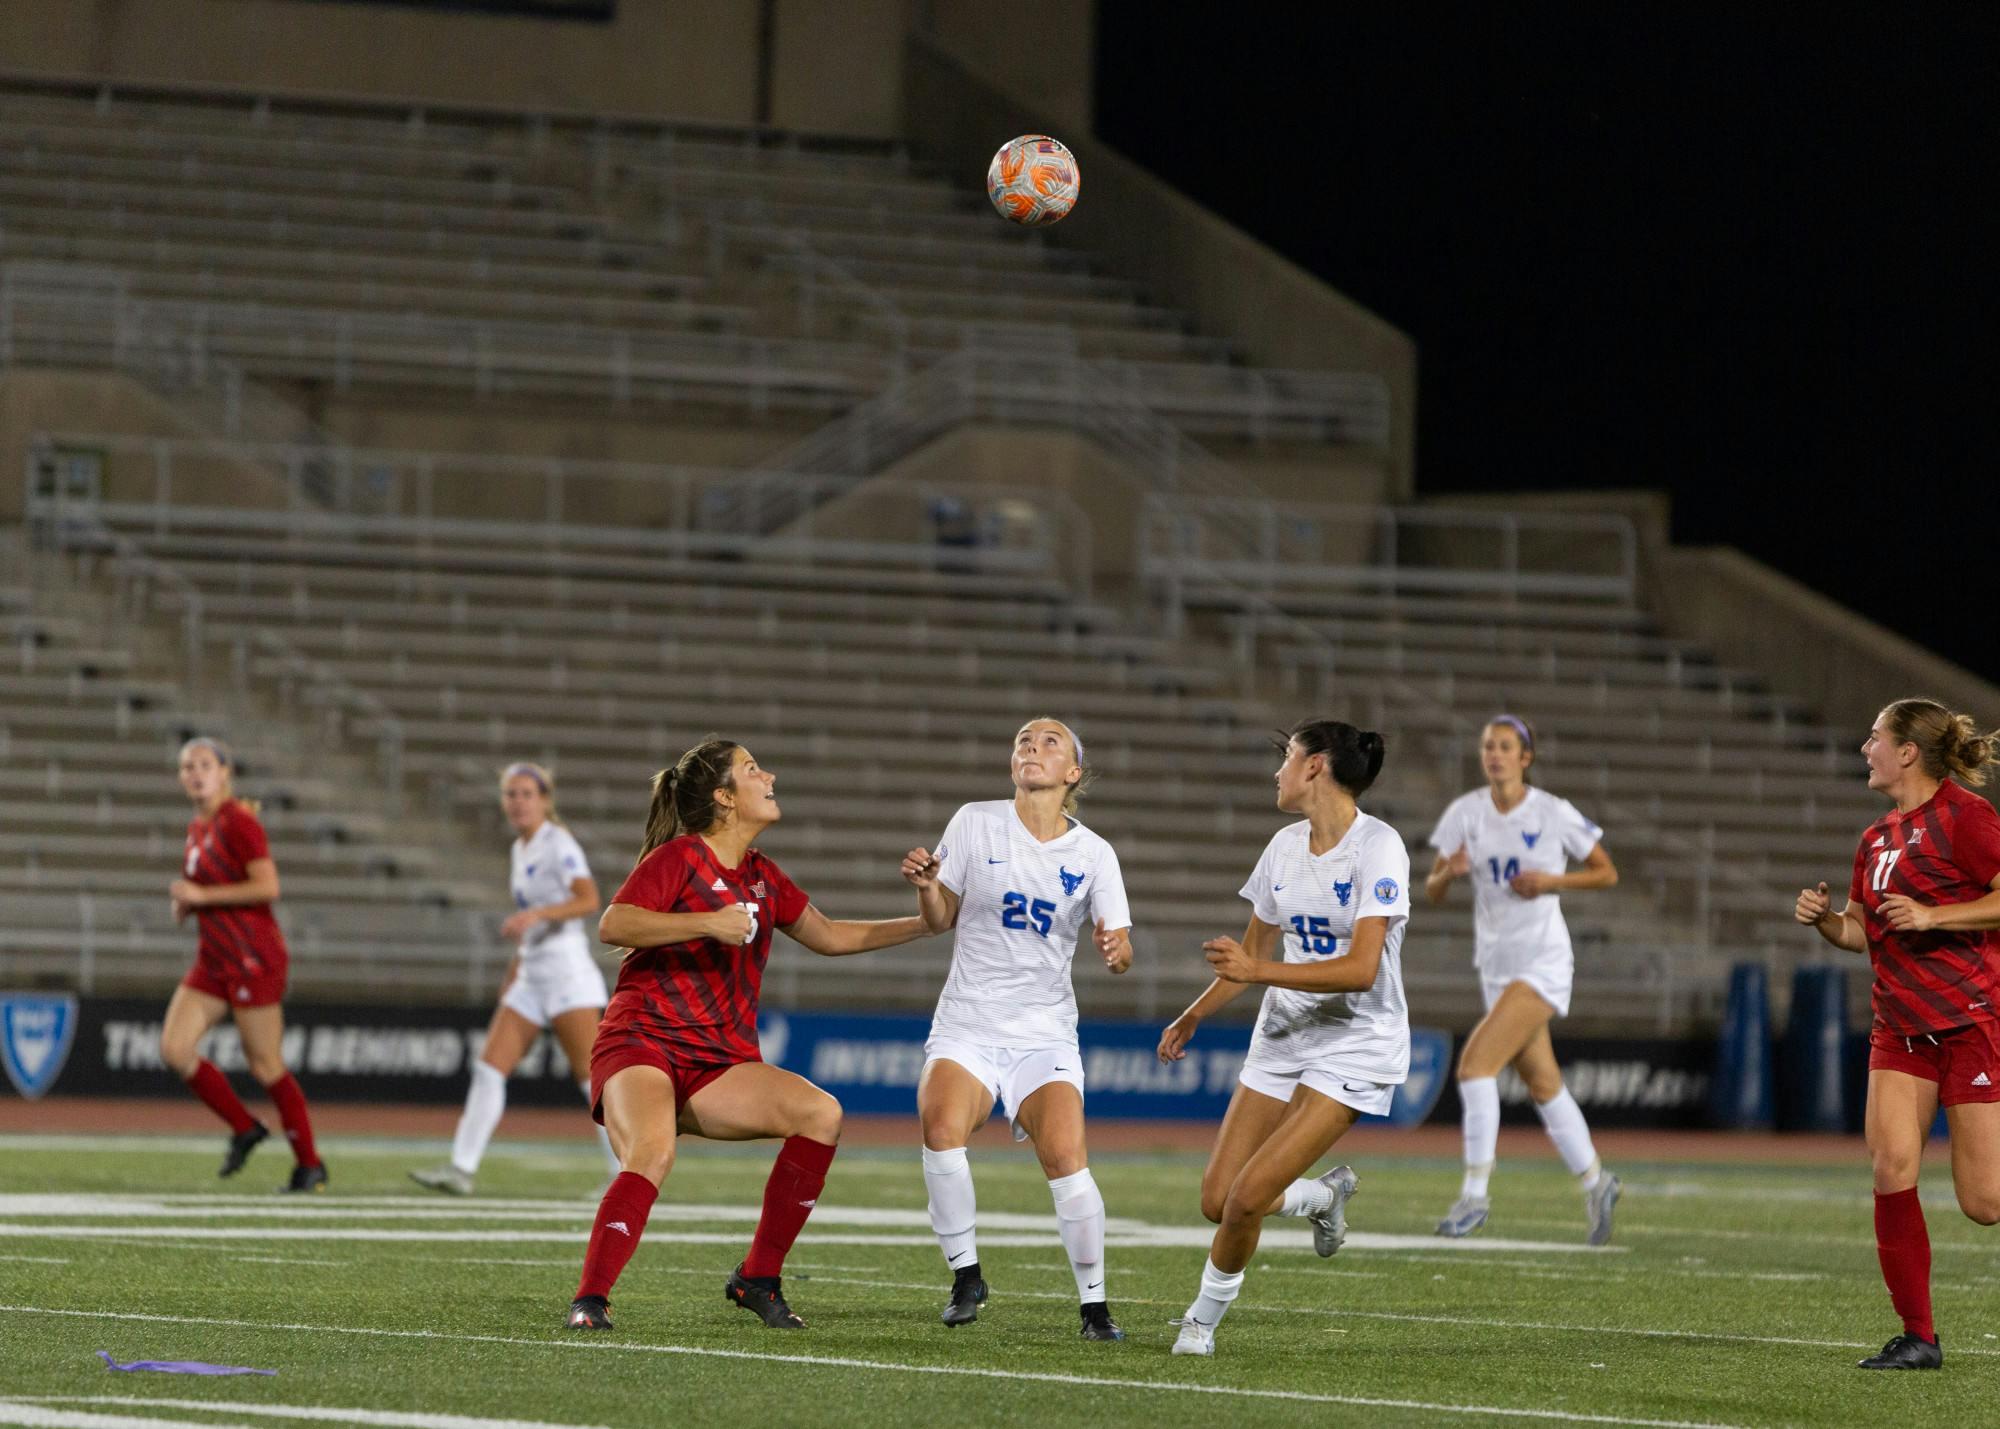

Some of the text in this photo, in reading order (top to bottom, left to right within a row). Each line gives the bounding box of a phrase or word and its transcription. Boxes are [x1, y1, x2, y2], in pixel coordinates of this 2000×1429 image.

[1872, 848, 1902, 891] 17
[735, 902, 760, 944] 5
[1002, 891, 1056, 938] 25
[1290, 915, 1337, 955] 15
[103, 1021, 164, 1070] TH
[307, 1024, 463, 1075] BEHIND
